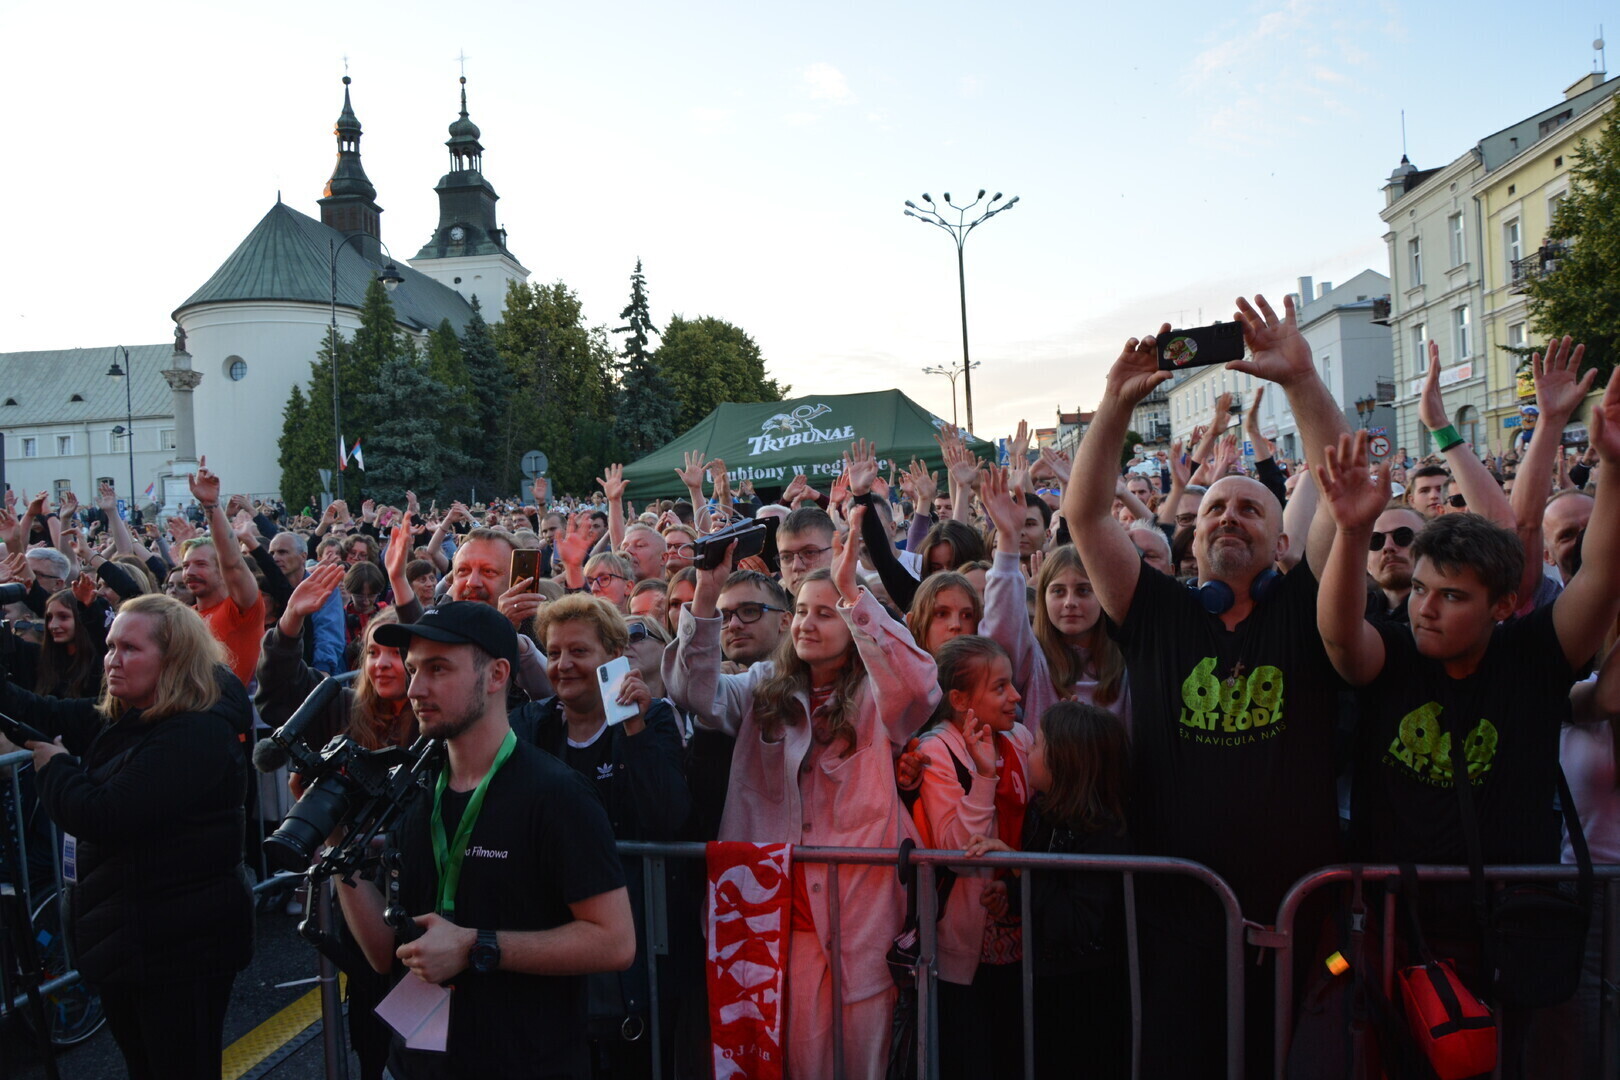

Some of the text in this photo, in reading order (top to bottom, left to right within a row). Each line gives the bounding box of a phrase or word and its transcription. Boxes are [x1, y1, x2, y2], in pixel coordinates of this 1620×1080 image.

[748, 425, 855, 456] TRYBUNAŁ
[792, 464, 806, 476] w
[1179, 707, 1220, 731] LAT
[1179, 728, 1190, 740] EX
[1195, 734, 1256, 747] NAVICULA
[1388, 737, 1429, 773] LAT
[471, 845, 509, 859] Filmowa
